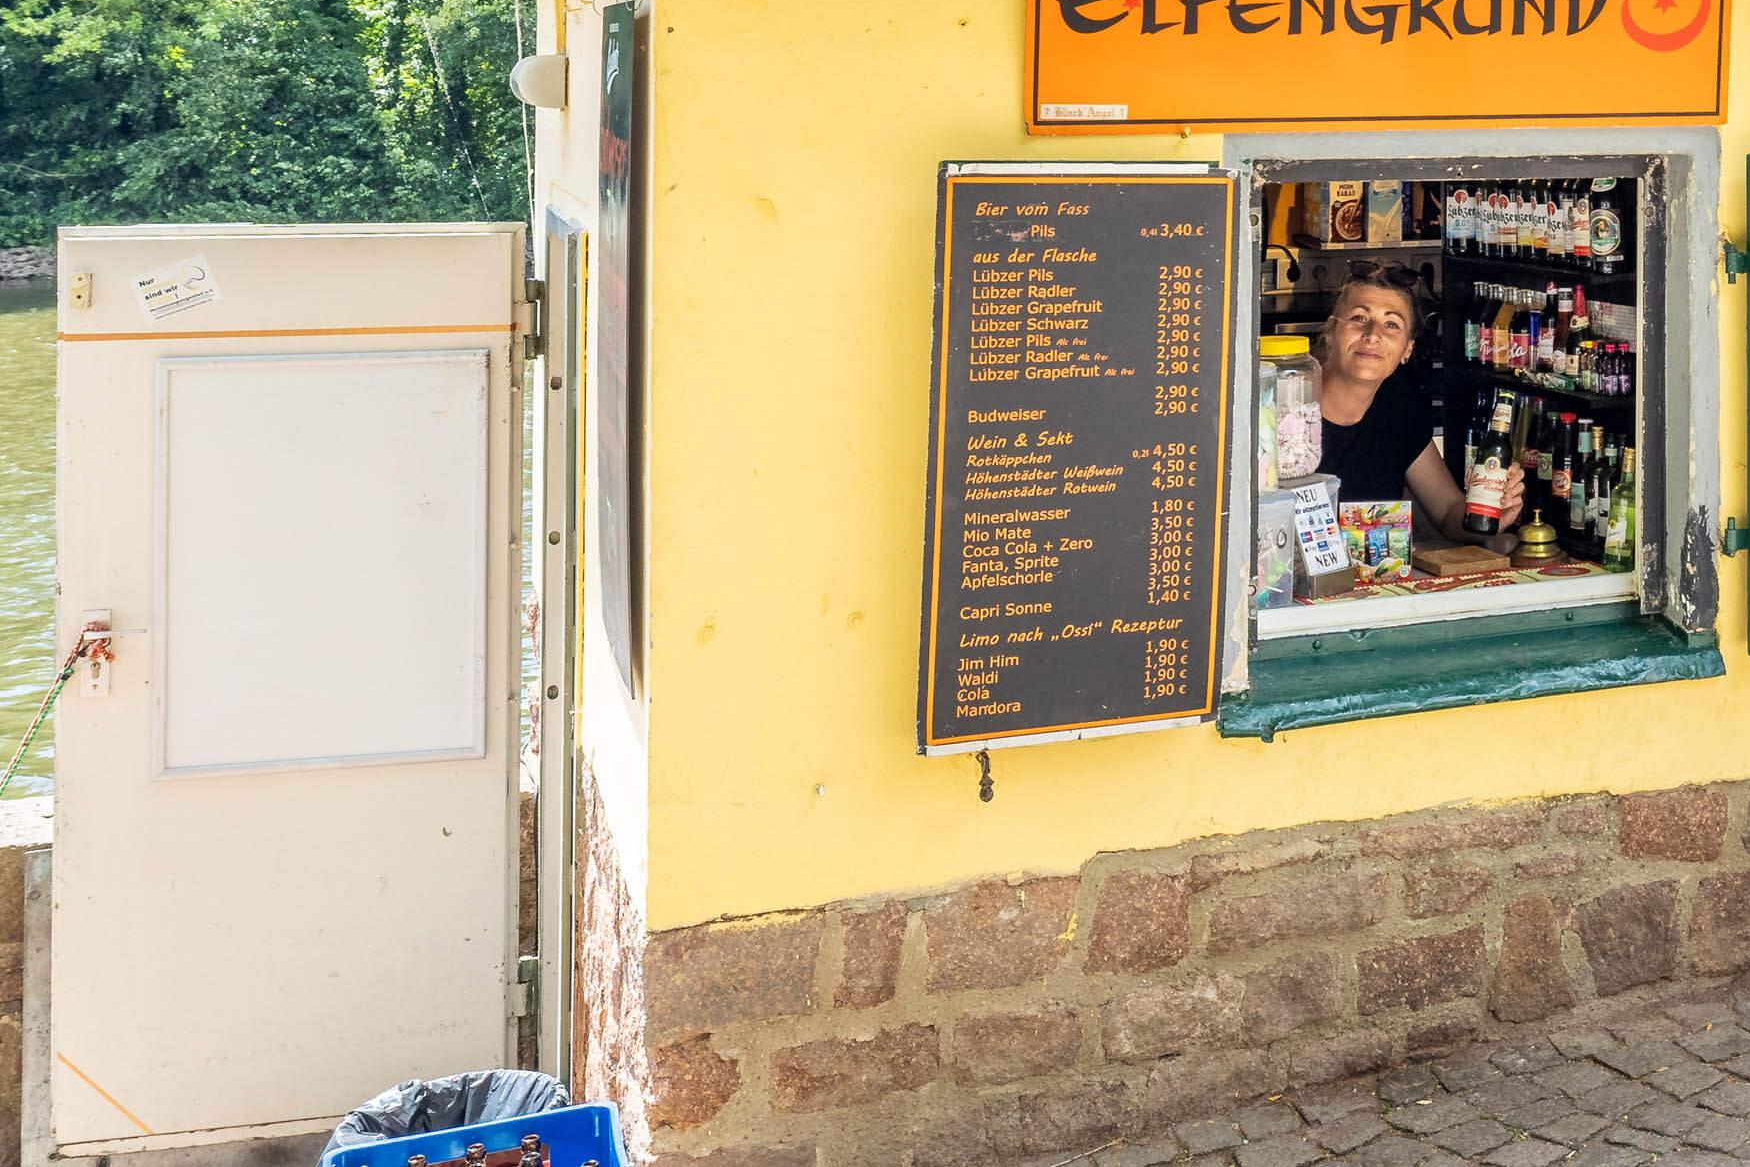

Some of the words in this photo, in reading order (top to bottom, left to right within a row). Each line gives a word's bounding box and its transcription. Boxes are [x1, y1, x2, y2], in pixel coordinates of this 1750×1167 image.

[975, 202, 1008, 216] Bier
[1016, 205, 1049, 216] vom
[1057, 201, 1089, 216] Fass
[1031, 224, 1056, 238] Pils
[973, 253, 1000, 264] aus
[1007, 247, 1035, 263] der
[1042, 247, 1097, 263] Flasche
[973, 269, 1024, 283] Lübzer
[1028, 268, 1054, 282] Pils
[972, 286, 1024, 300] Lübzer
[1028, 284, 1076, 298] Radler
[972, 302, 1022, 316] Lübzer
[1027, 300, 1103, 316] Grapefruit
[971, 318, 1022, 332] Lübzer
[1026, 317, 1088, 331] Schwarz
[971, 335, 1022, 349] Lübzer
[1026, 333, 1052, 347] Pils
[970, 351, 1021, 365] Lübzer
[1025, 349, 1074, 363] Radler
[1025, 364, 1100, 381] Grapefruit
[968, 409, 1047, 423] Budweiser
[967, 434, 1007, 451] Wein
[1036, 430, 1073, 447] Sekt
[966, 452, 1052, 468] Rotkäppchen
[965, 468, 1057, 485] Höhenstädter
[1063, 465, 1124, 480] Weißwein
[964, 484, 1057, 501] Höhenstädter
[1062, 481, 1117, 495] Rotwein
[1296, 488, 1318, 503] NEU
[964, 509, 1071, 525] Mineralwasser
[963, 529, 990, 543] Mio
[995, 527, 1032, 540] Mate
[962, 545, 1000, 558] Coca
[1004, 541, 1037, 555] Cola
[1059, 538, 1093, 551] Zero
[962, 559, 1009, 574] Fanta,
[1014, 555, 1059, 571] Sprite
[1314, 552, 1338, 568] NEW
[961, 569, 1053, 591] Apfelschorle
[960, 604, 1000, 621] Capri
[1005, 602, 1052, 616] Sonne
[959, 633, 1000, 648] Limo
[1007, 626, 1044, 642] nach
[1111, 618, 1183, 634] Rezeptur
[957, 658, 984, 671] Jim
[990, 655, 1019, 668] Him
[958, 670, 999, 687] Waldi
[957, 687, 990, 702] Cola
[956, 701, 1021, 718] Mandora
